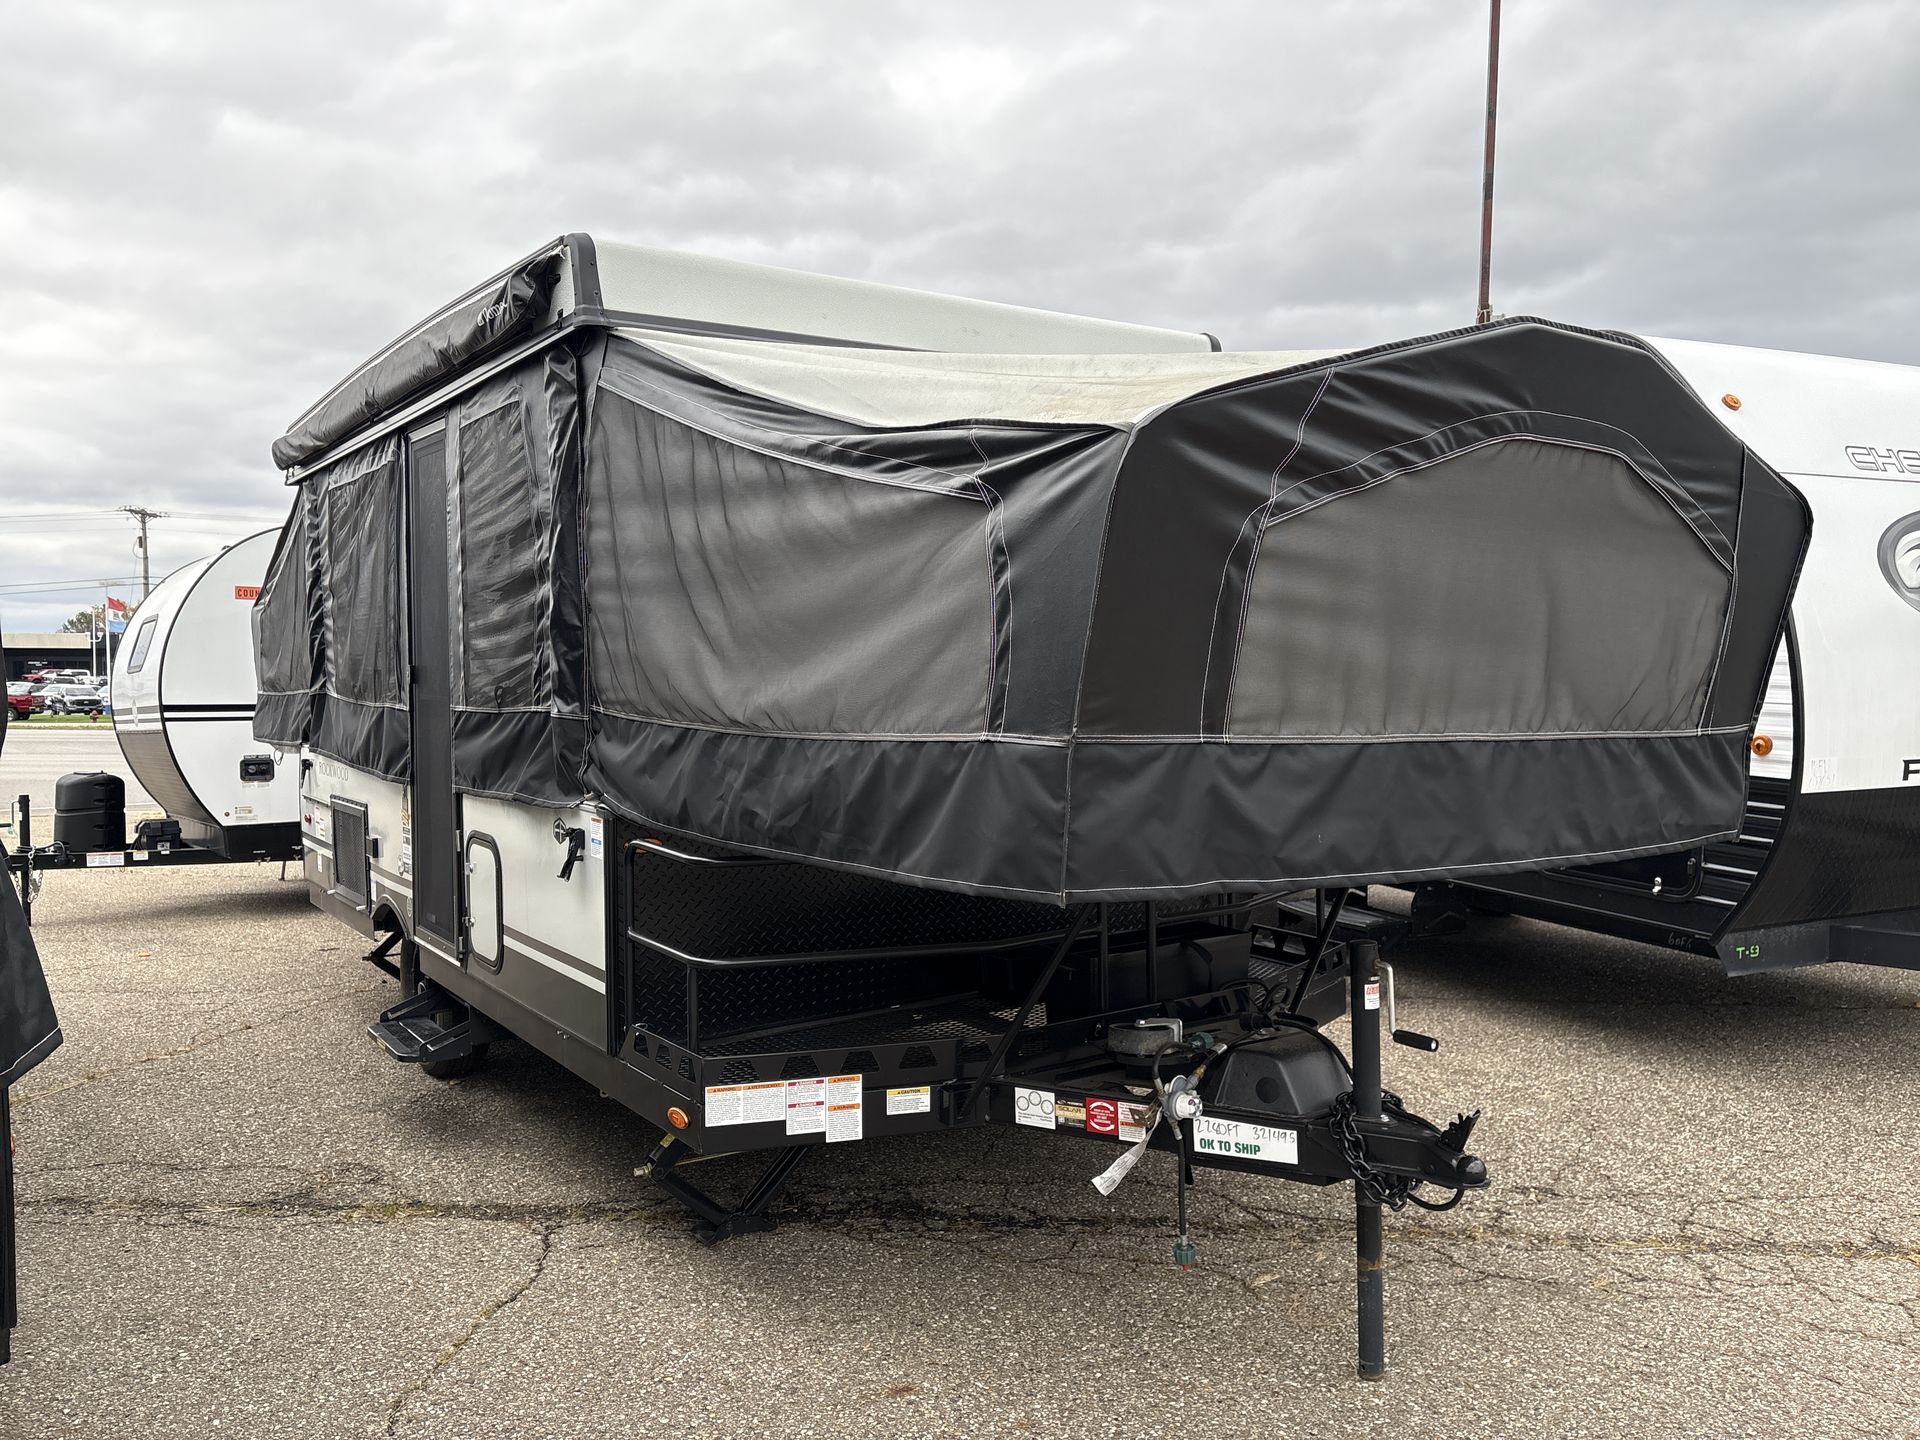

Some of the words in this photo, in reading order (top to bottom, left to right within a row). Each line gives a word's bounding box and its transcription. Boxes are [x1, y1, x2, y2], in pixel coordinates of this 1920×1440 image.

[319, 761, 349, 781] ROCKWOOD
[1200, 1138, 1215, 1150] OK
[1217, 1140, 1231, 1152] TO
[1234, 1142, 1261, 1155] SHIP
